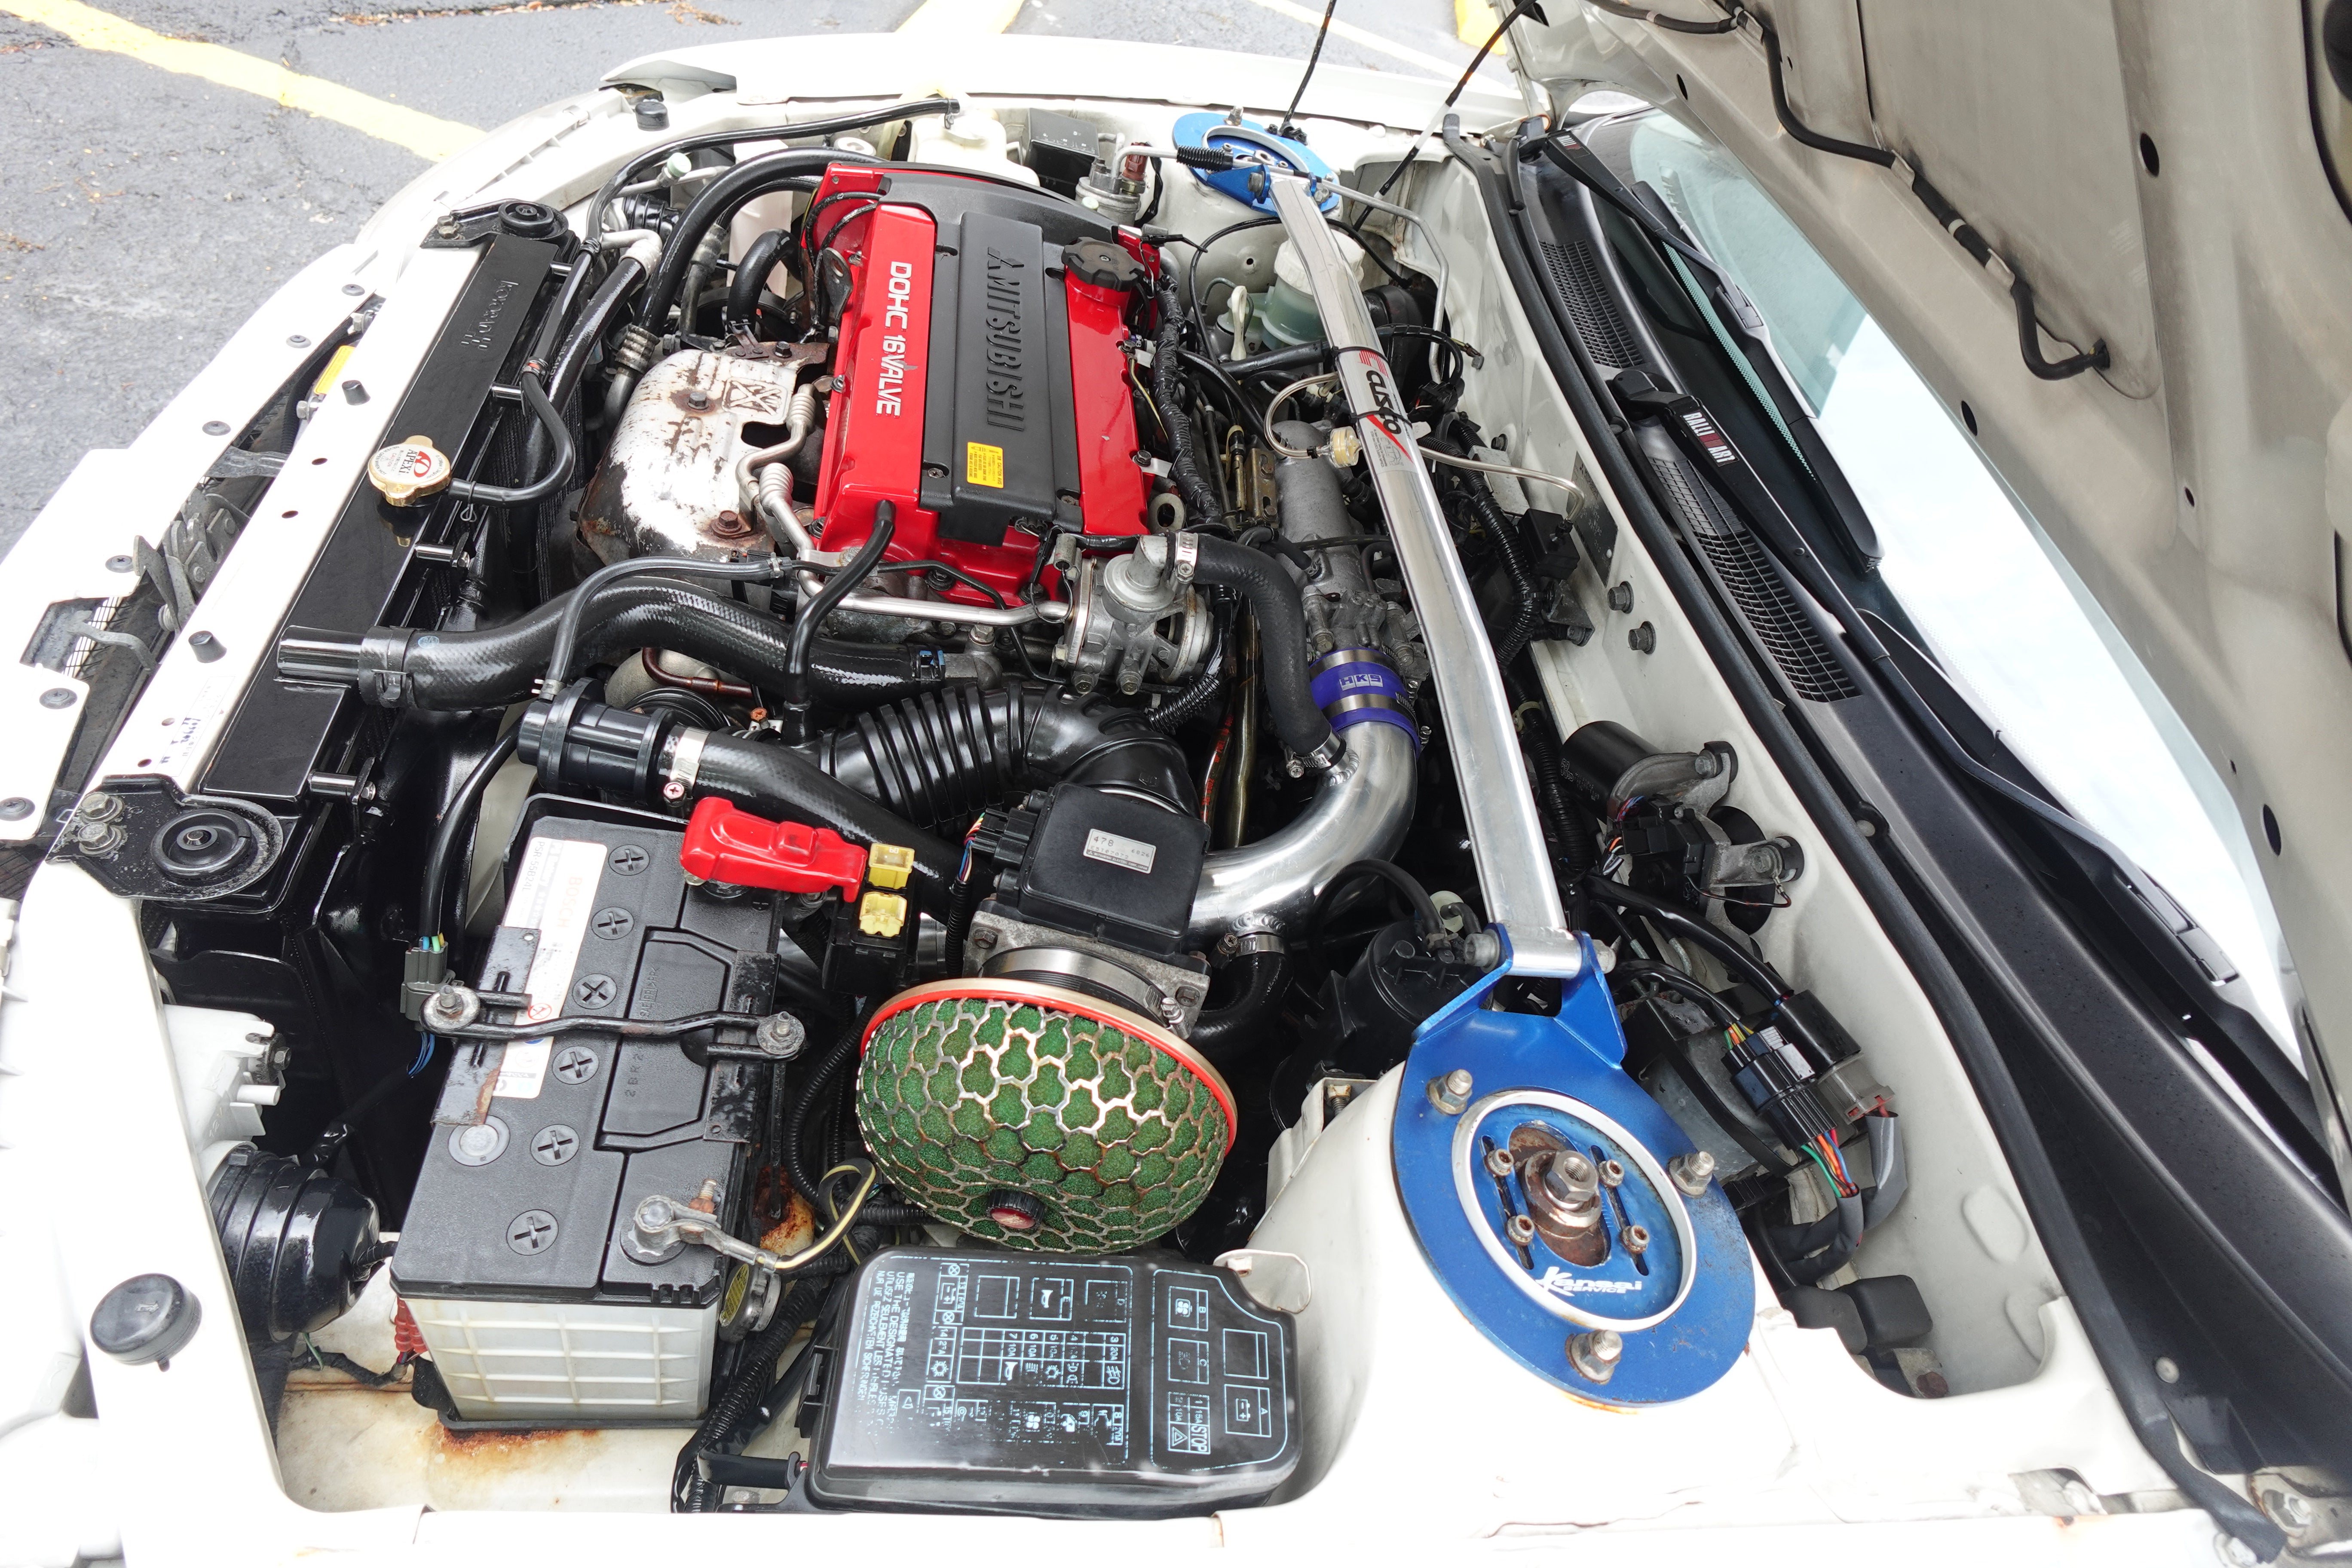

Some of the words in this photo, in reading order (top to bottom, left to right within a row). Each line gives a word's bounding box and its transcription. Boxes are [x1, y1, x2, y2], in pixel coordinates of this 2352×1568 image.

[884, 261, 913, 331] DOHC
[986, 273, 1025, 432] MITSUBISHI
[387, 453, 398, 467] CAUTION
[1338, 673, 1384, 692] HKS
[1094, 836, 1114, 847] 478
[1131, 849, 1150, 858] 6826
[557, 876, 583, 928] BOSCH
[876, 1270, 886, 1284] NUR
[894, 1271, 905, 1291] USE
[1534, 1266, 1642, 1296] Kansai
[959, 1282, 966, 1290] 13
[891, 1294, 903, 1313] THE
[1199, 1305, 1206, 1314] B
[876, 1305, 890, 1348] SEULEMENT
[940, 1328, 949, 1337] 14
[873, 1351, 884, 1366] LES
[1028, 1344, 1037, 1358] 10A
[1199, 1358, 1207, 1367] C
[1194, 1409, 1203, 1424] 15A
[1261, 1407, 1268, 1415] A
[1191, 1425, 1207, 1452] STOP
